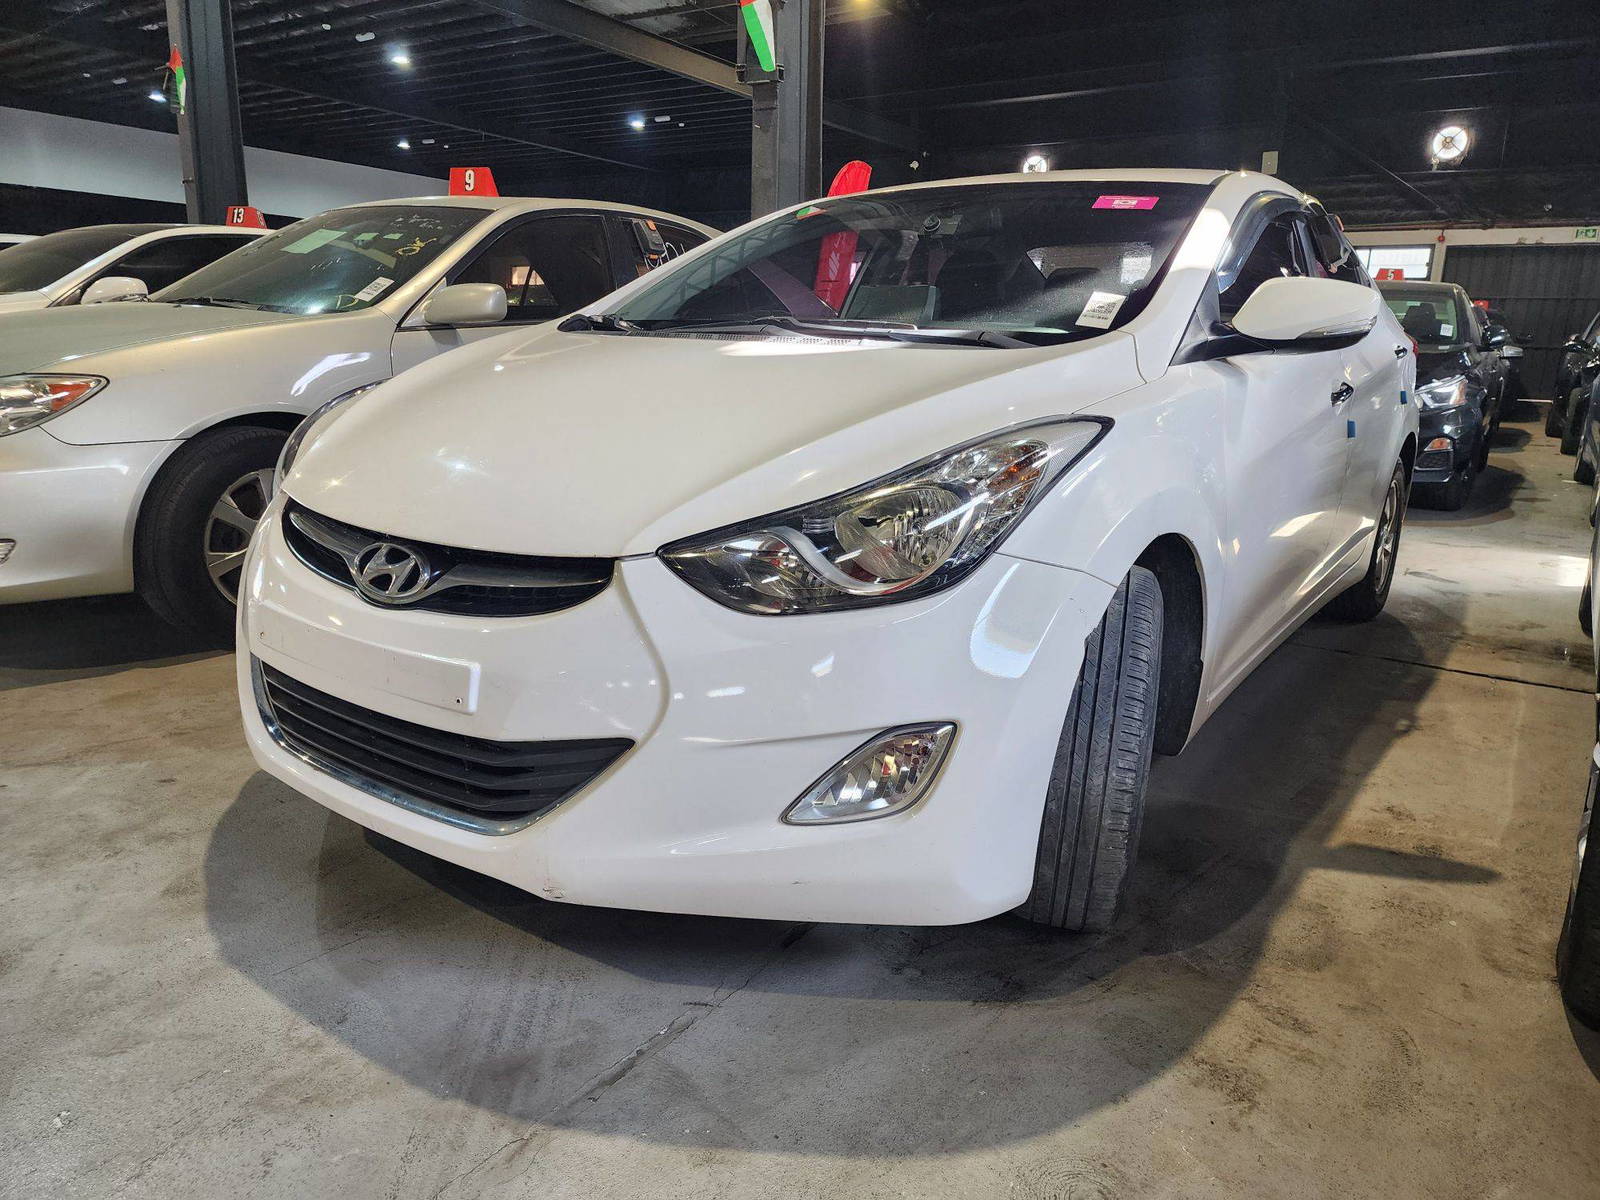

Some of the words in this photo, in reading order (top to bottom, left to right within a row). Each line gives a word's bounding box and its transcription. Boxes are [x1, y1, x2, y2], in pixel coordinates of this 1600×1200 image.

[465, 169, 475, 191] 9
[233, 207, 244, 223] 13
[1386, 269, 1395, 281] 5
